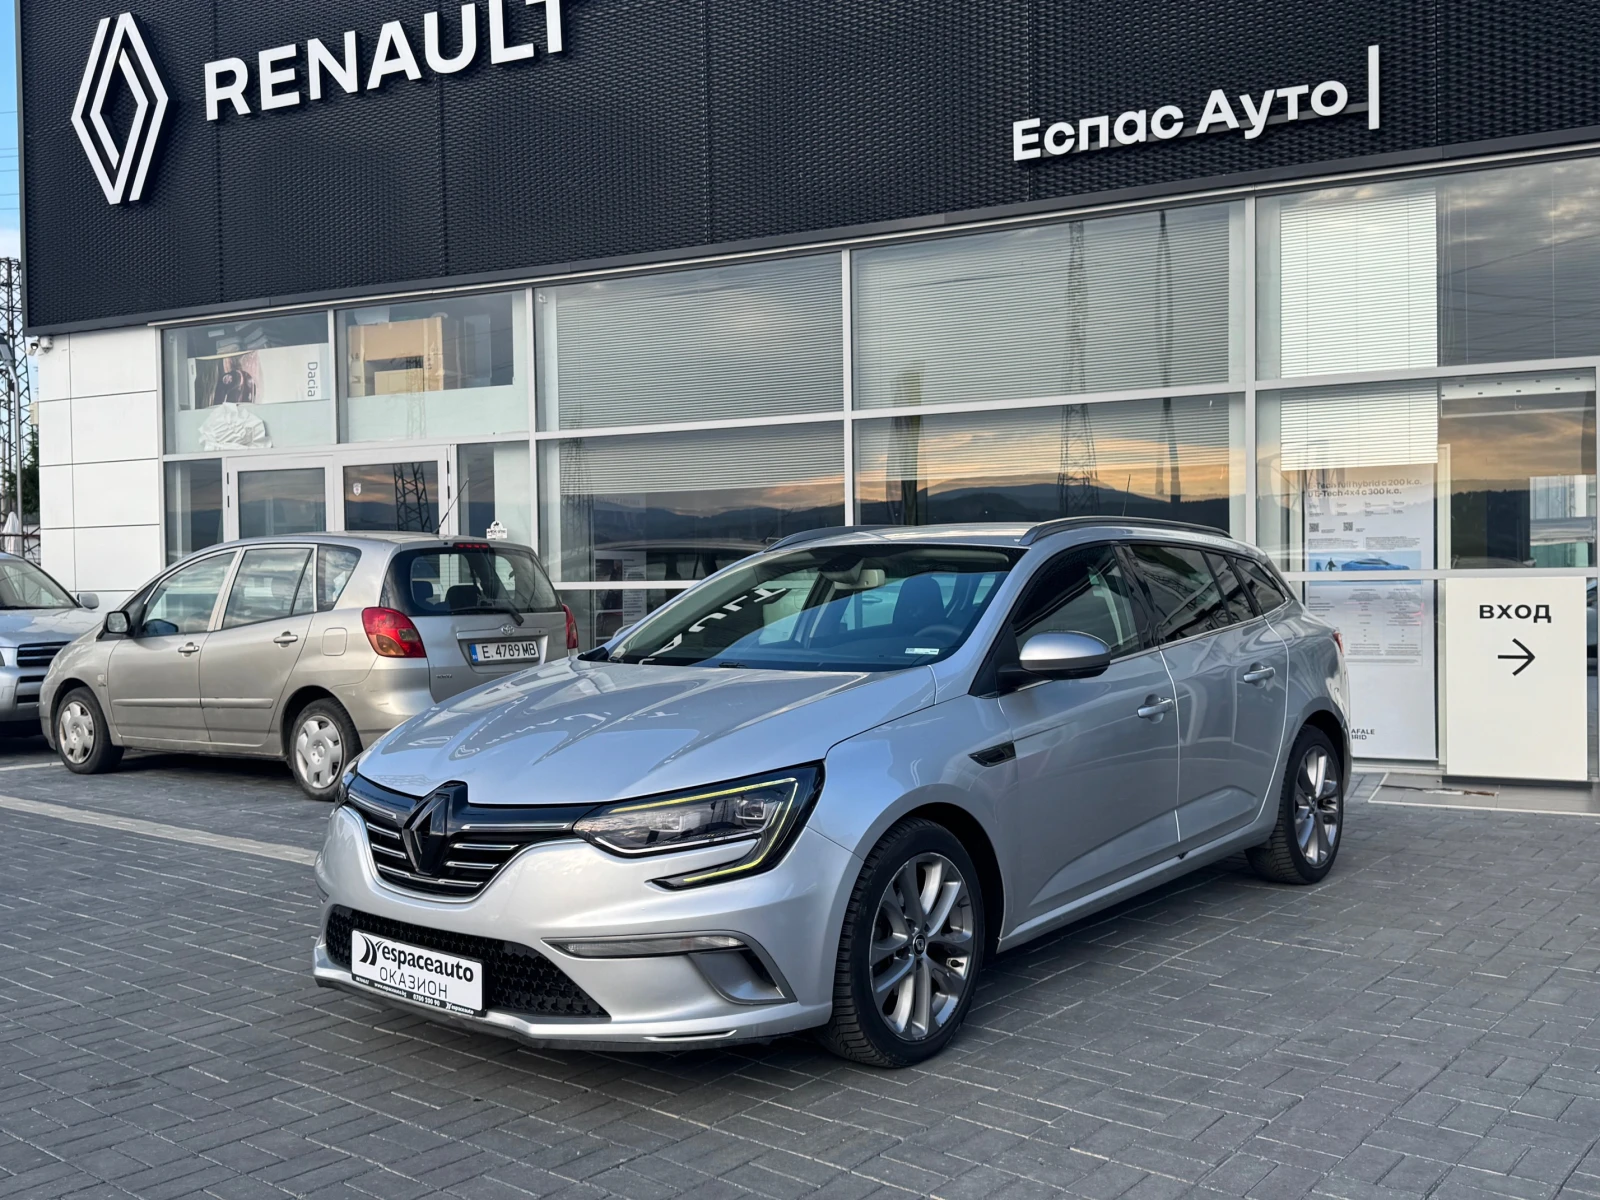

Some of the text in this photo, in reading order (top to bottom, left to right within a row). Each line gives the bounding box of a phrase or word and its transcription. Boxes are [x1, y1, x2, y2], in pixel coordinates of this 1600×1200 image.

[204, 0, 563, 121] RENAULT
[1012, 79, 1349, 162] Еспас Ауто
[307, 361, 319, 398] Dacia
[1344, 488, 1360, 496] 4x4
[1368, 487, 1385, 495] 300
[1352, 480, 1380, 489] hybrid
[1388, 478, 1405, 486] 200
[1479, 604, 1552, 624] ВХОД
[381, 945, 474, 982] espaceauto
[379, 966, 448, 999] ОКАЗИОН
